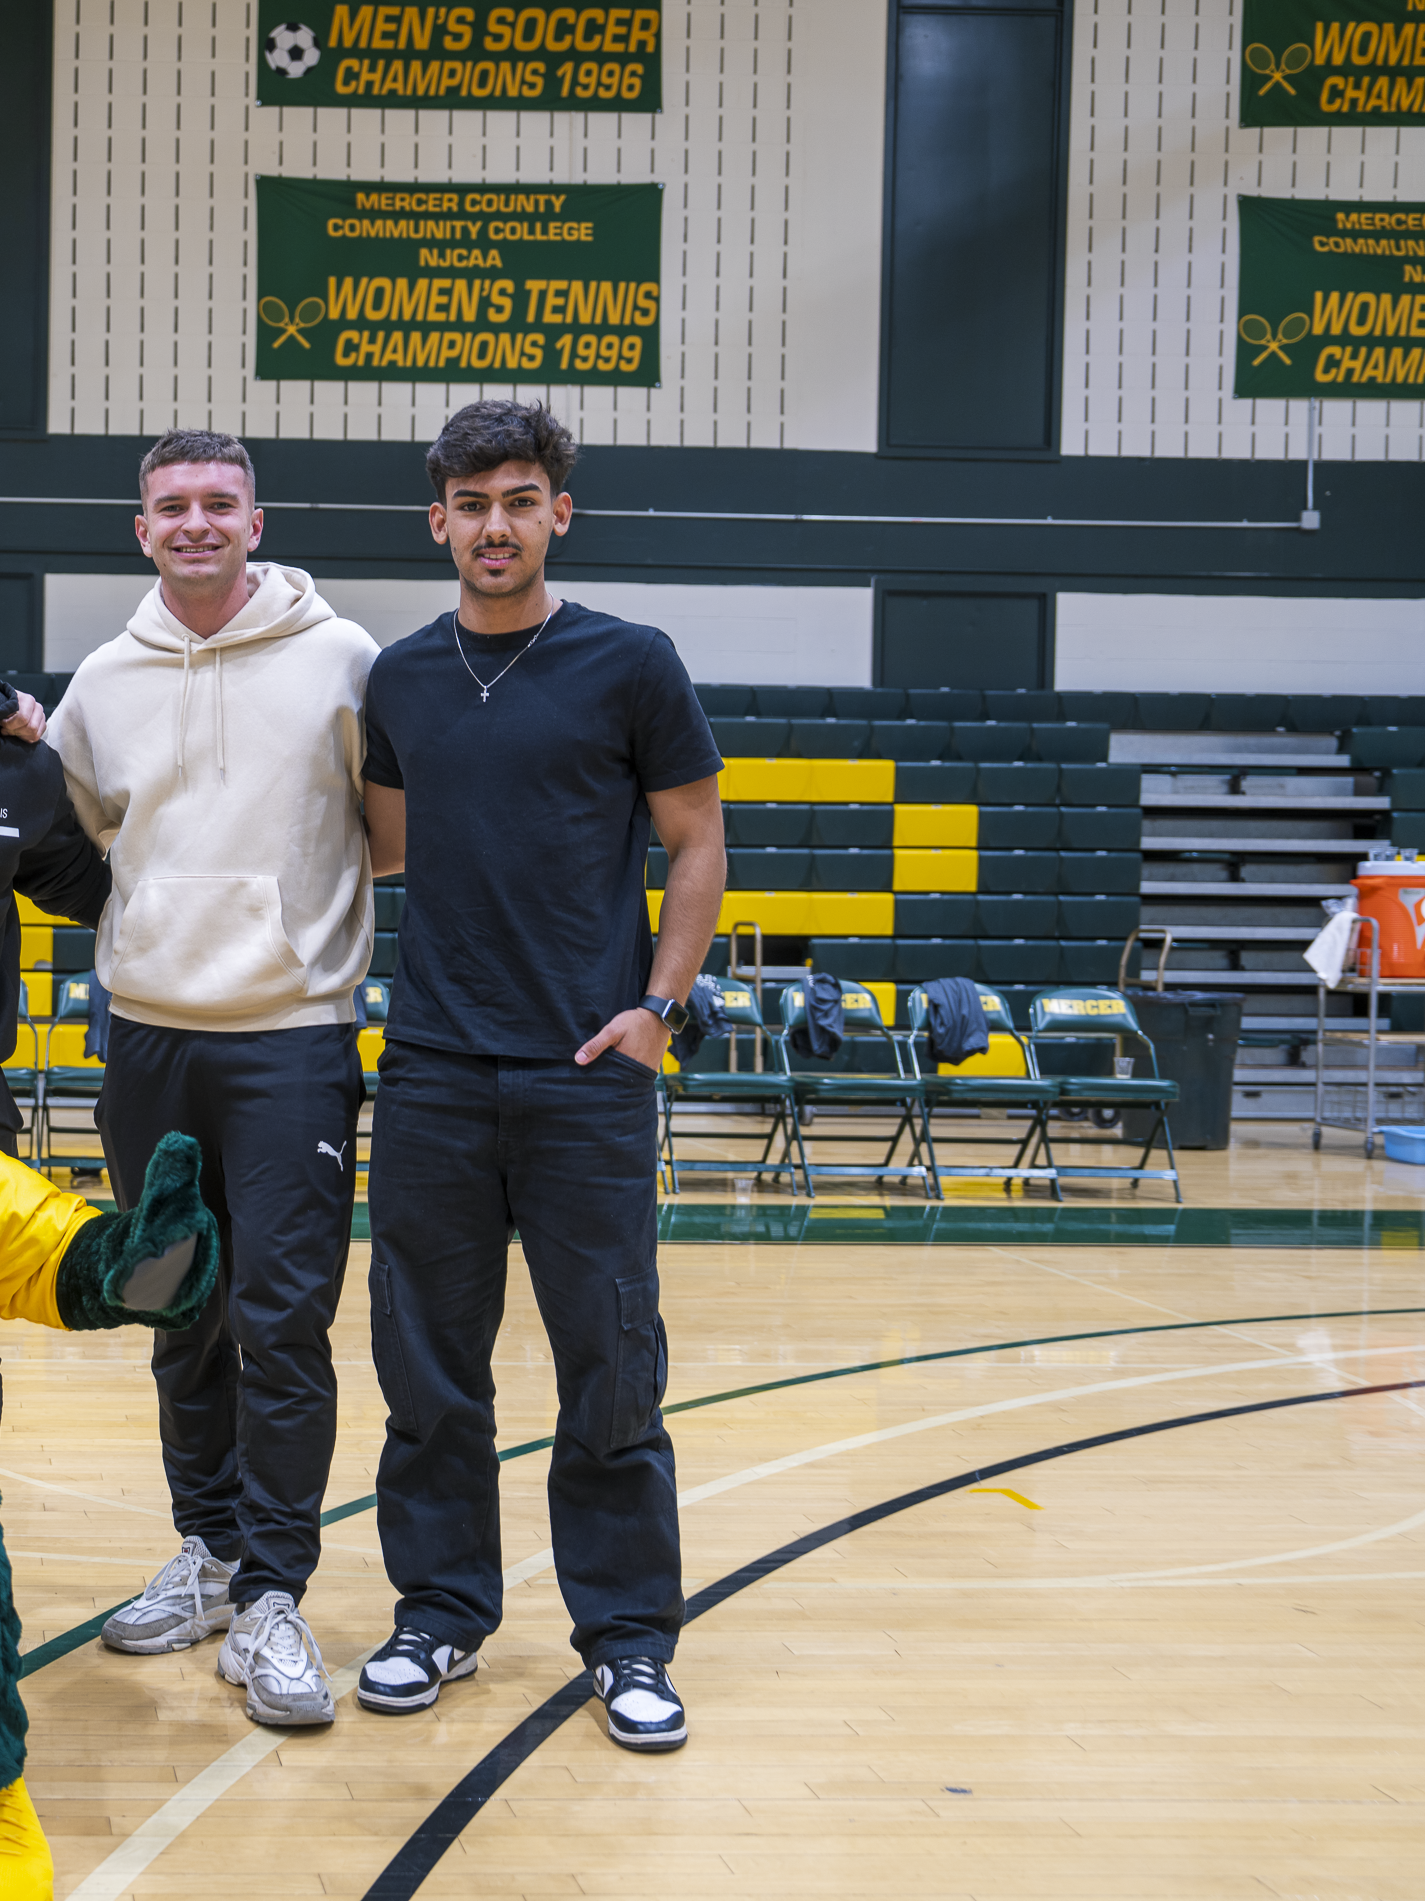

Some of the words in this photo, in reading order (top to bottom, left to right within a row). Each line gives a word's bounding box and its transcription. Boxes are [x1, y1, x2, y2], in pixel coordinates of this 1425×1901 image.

[328, 4, 475, 51] MEN'S
[483, 7, 660, 53] SOCCER
[334, 58, 546, 98] CHAMPIONS
[555, 61, 644, 100] 1996
[1320, 75, 1425, 113] CHAM
[355, 192, 459, 213] MERCER
[464, 194, 567, 213] COUNTY
[1335, 212, 1425, 231] MERCE
[326, 217, 483, 241] COMMUNITY
[487, 220, 594, 242] COLLEGE
[1312, 235, 1425, 257] COMMUN
[419, 247, 503, 269] NJCAA
[327, 275, 515, 323] WOMEN'S
[524, 279, 661, 327] TENNIS
[1310, 289, 1425, 338] WOME
[334, 329, 546, 370] CHAMPIONS
[554, 333, 643, 373] 1999
[1312, 338, 1425, 384] CHAM
[1041, 997, 1127, 1017] MERCER
